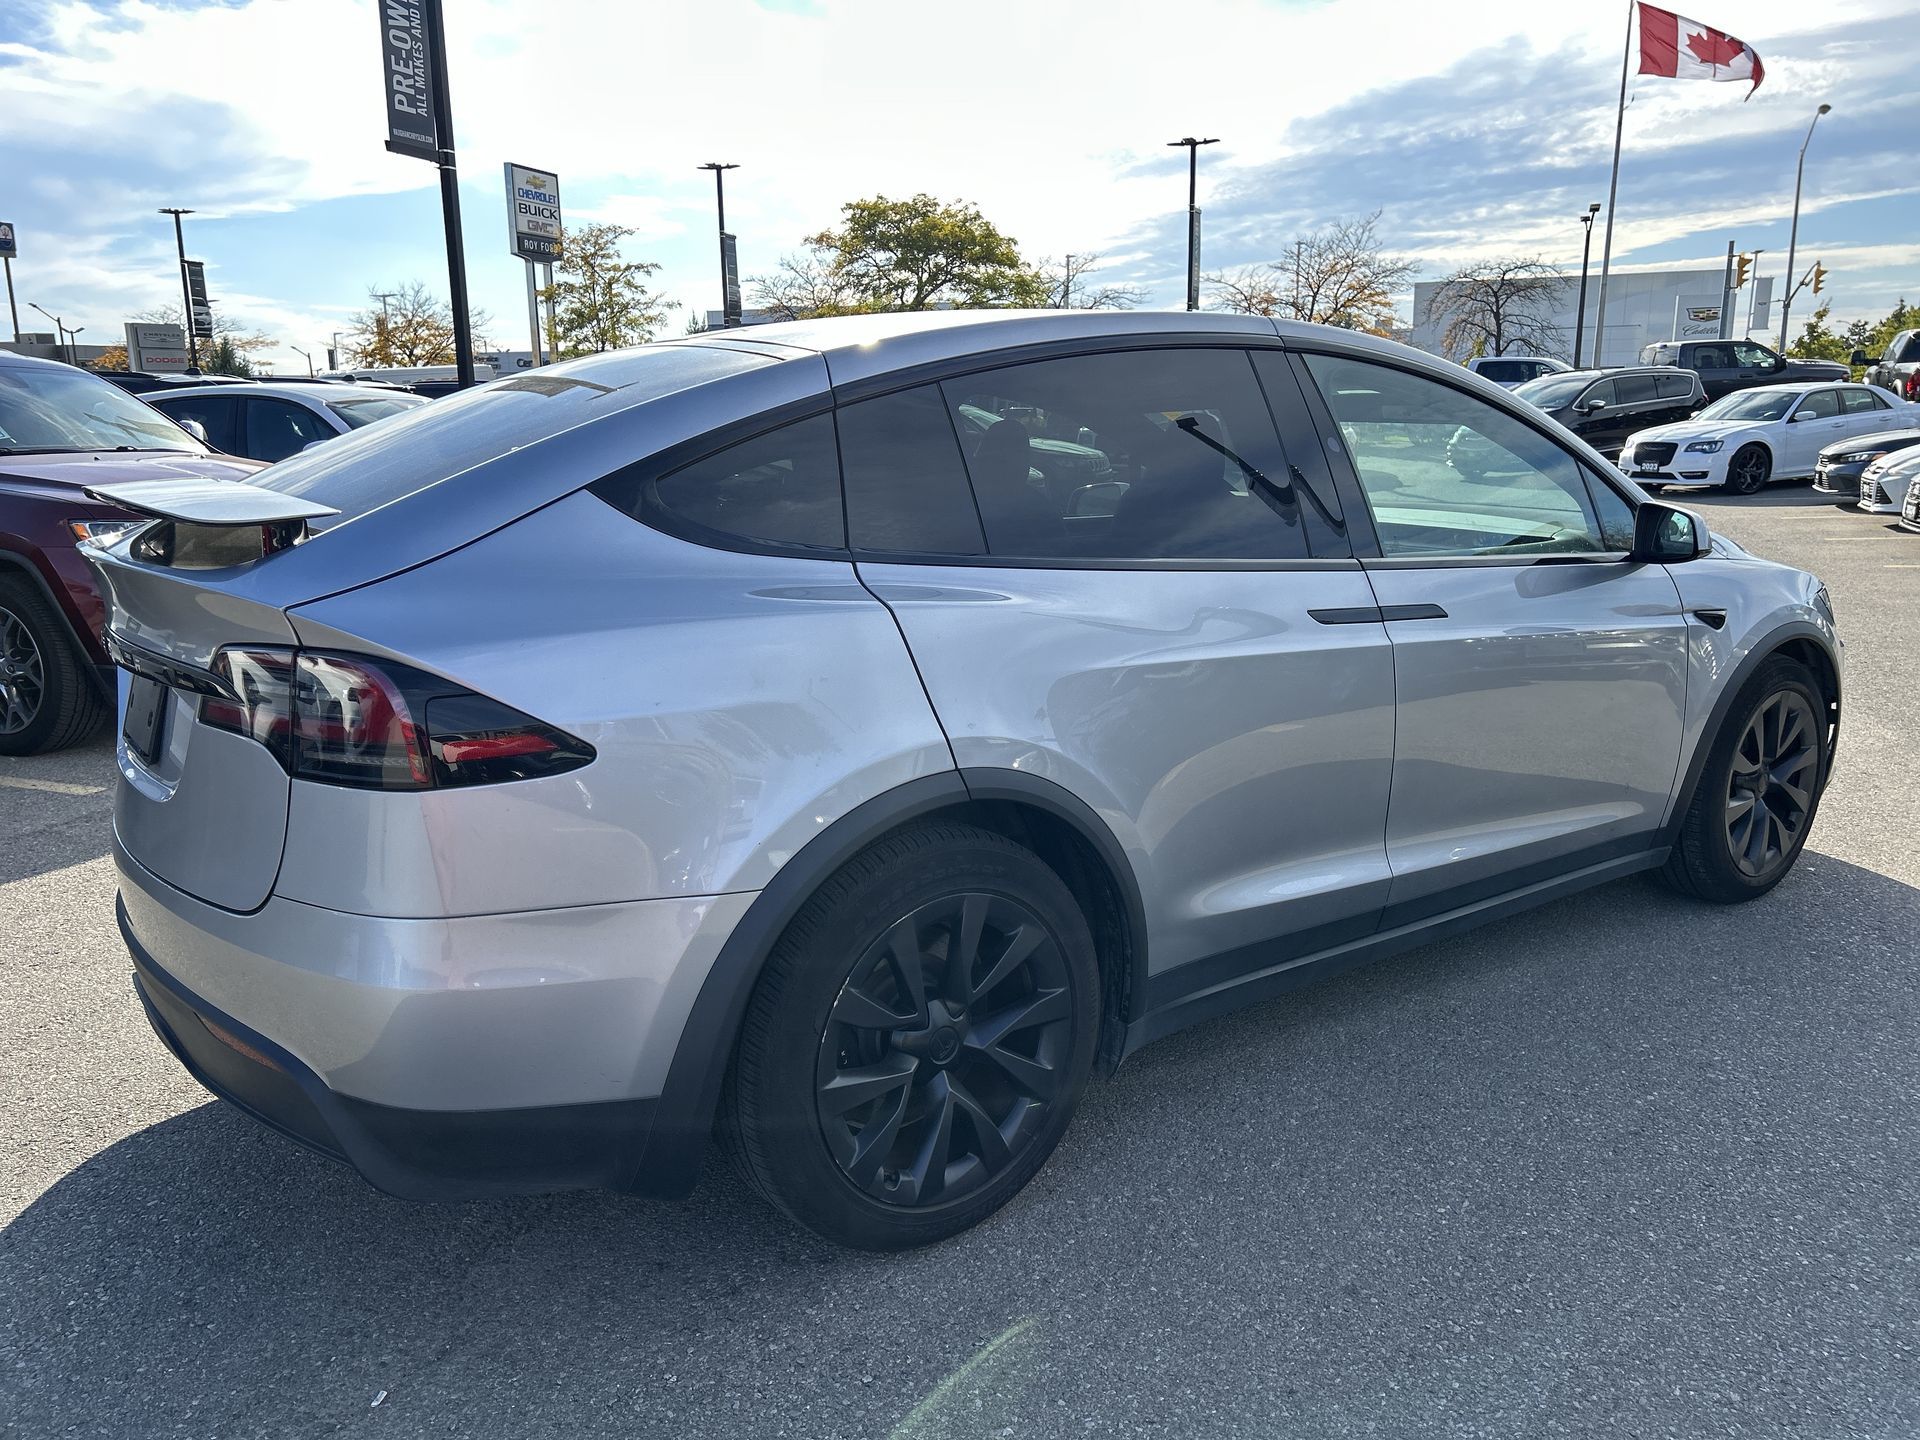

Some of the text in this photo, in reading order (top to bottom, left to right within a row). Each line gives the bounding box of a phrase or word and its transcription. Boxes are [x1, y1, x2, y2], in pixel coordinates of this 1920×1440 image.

[409, 8, 422, 38] AND
[386, 0, 417, 115] PRE-OW
[413, 41, 425, 89] MAKES
[416, 93, 428, 117] ALL
[518, 188, 556, 204] CHEVROLET
[518, 203, 558, 220] BUICK
[528, 220, 553, 234] GMC
[524, 239, 538, 250] ROY
[1682, 324, 1719, 337] Cadilla
[1641, 462, 1658, 471] 2023
